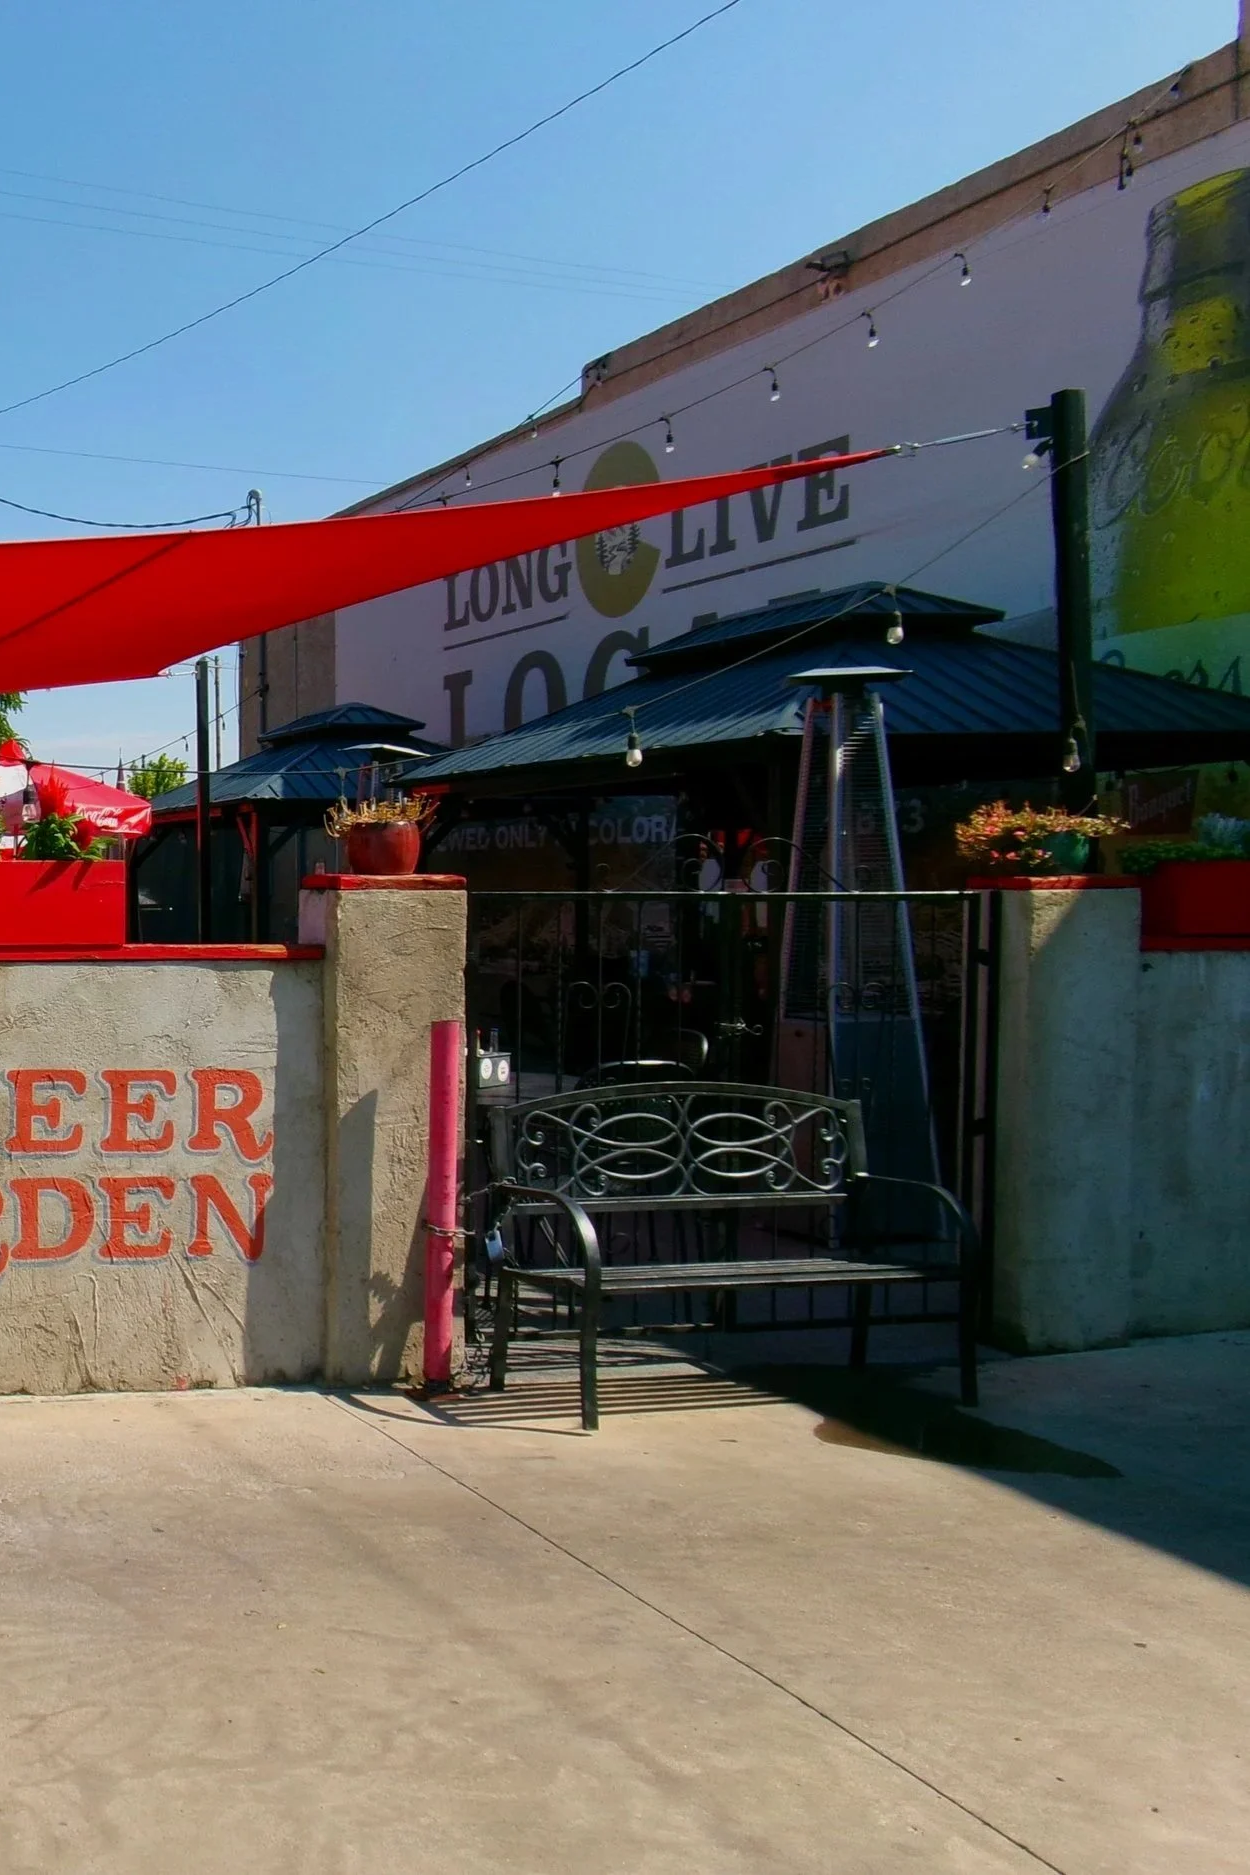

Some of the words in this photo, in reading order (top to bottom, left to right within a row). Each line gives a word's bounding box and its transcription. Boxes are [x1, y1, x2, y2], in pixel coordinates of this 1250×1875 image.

[443, 538, 572, 631] LONG
[664, 434, 850, 569] LIVE
[494, 823, 549, 850] ONLY
